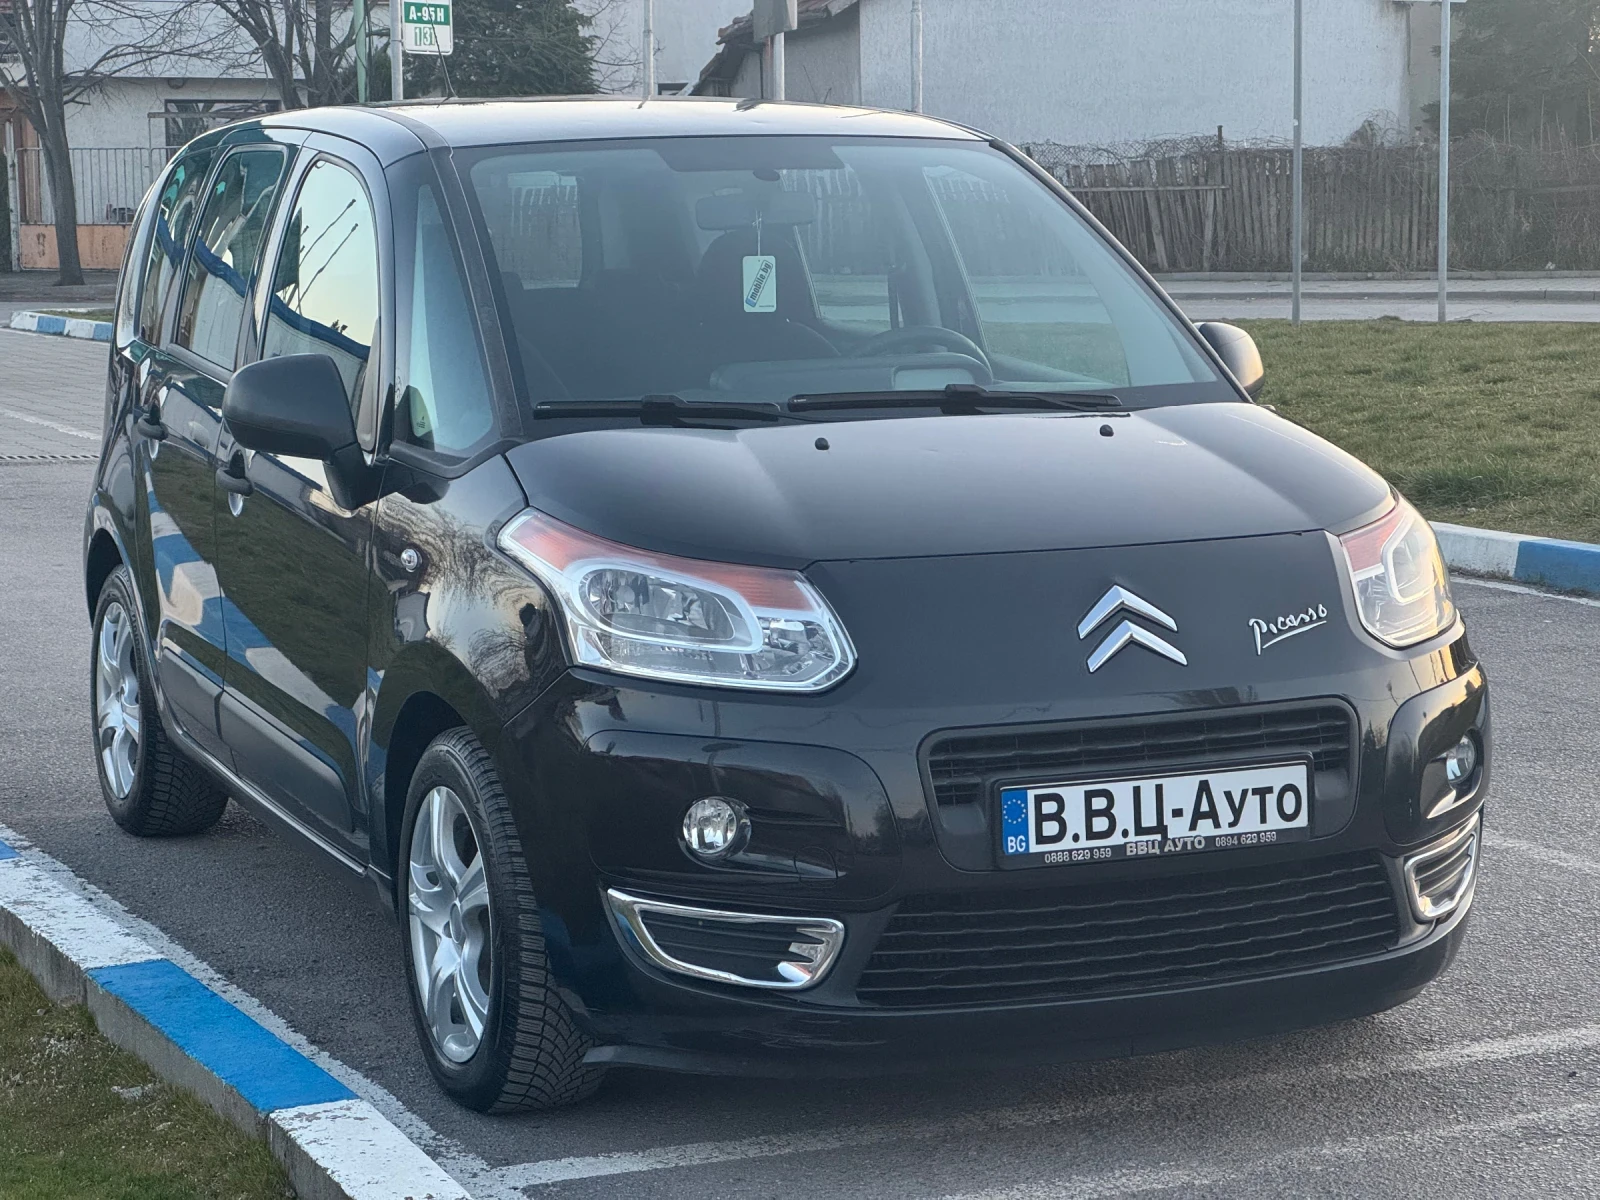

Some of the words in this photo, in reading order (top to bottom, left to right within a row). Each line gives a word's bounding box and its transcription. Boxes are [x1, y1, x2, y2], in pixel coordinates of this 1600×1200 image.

[749, 262, 772, 301] mobile.bg
[1248, 603, 1328, 656] Picasso
[1034, 779, 1303, 846] В.В.Ц-Ауто
[1007, 835, 1026, 853] BG
[1125, 840, 1161, 856] ВВЦ
[1163, 836, 1206, 853] АУТО
[1215, 837, 1239, 847] 0894
[1240, 833, 1258, 845] 629
[1260, 831, 1277, 843] 959
[1044, 853, 1070, 863] 0888
[1071, 850, 1091, 861] 629
[1093, 847, 1112, 859] 959
